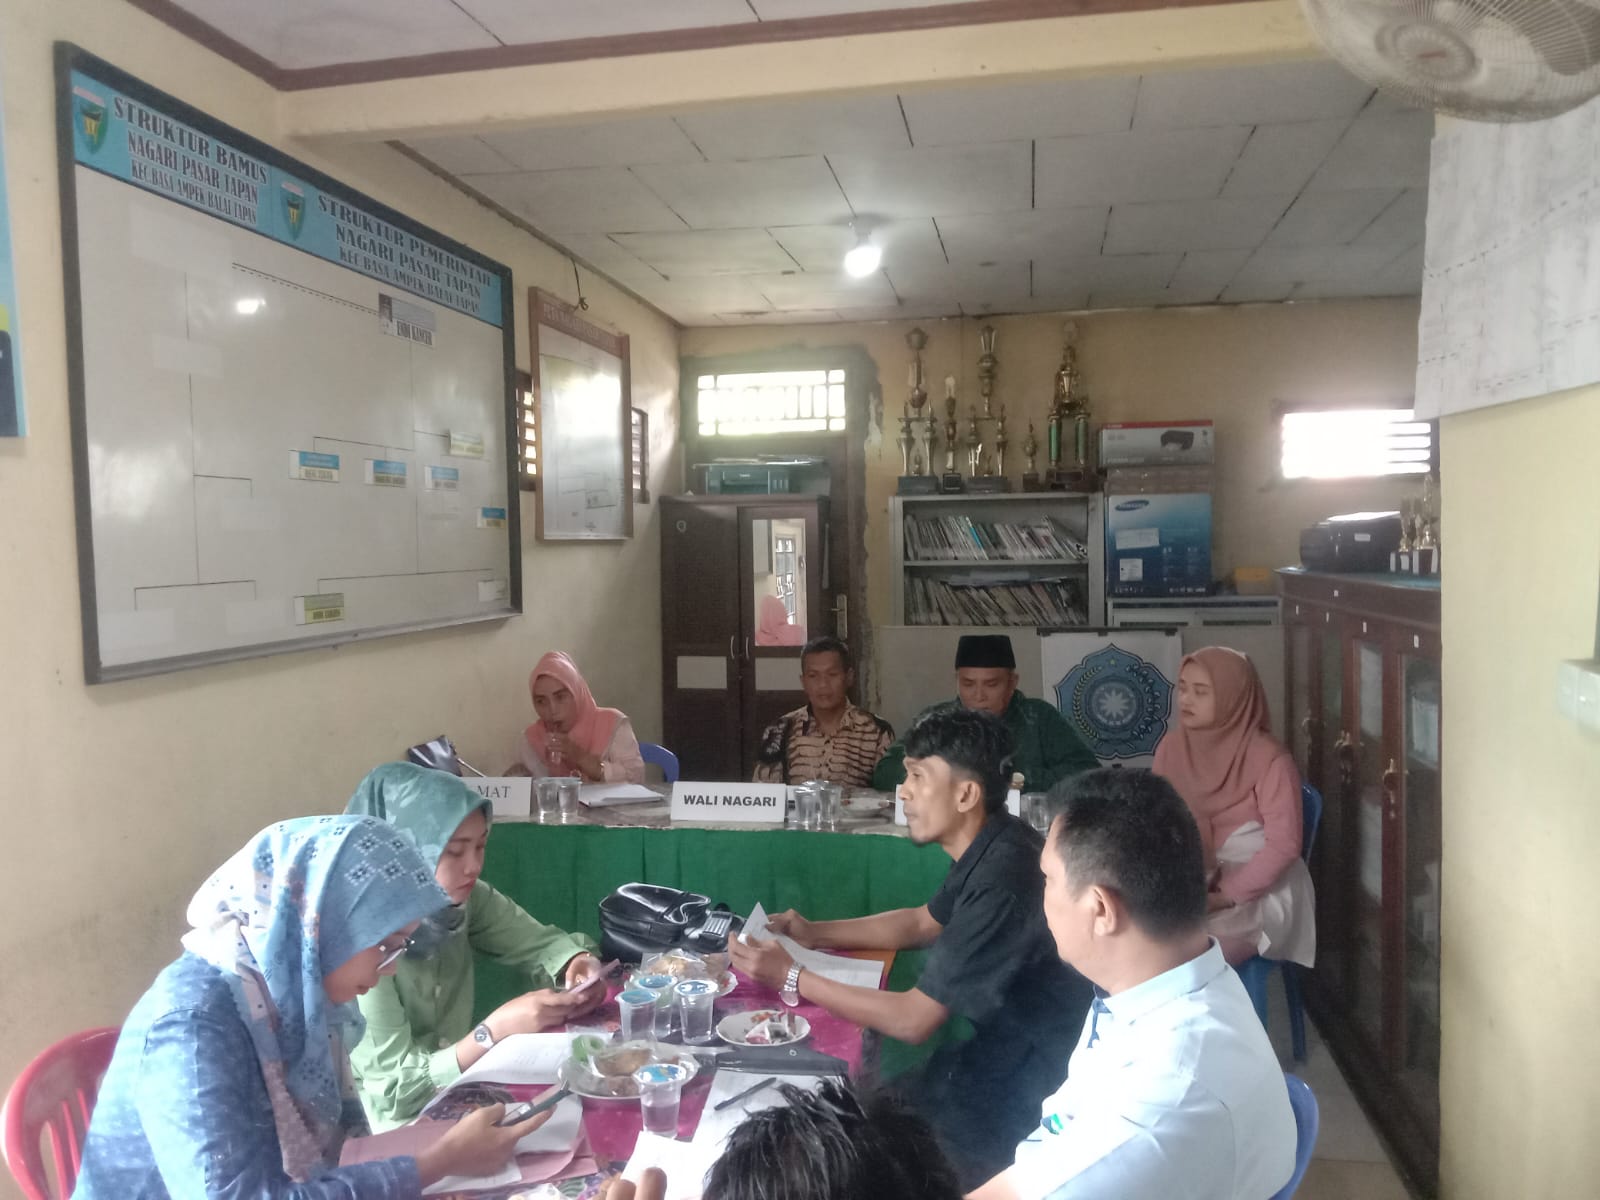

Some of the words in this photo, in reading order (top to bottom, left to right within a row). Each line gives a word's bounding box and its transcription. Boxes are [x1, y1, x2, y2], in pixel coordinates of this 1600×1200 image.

[114, 97, 210, 158] STRUKTUR
[216, 145, 267, 184] BAMUS
[128, 132, 178, 171] NAGARI
[183, 155, 220, 189] PASAR
[225, 175, 258, 205] TAPAN
[318, 195, 404, 247] STRUKTUR
[410, 238, 491, 287] PEMERINTAH
[336, 224, 394, 262] NAGARI
[399, 252, 441, 283] PASAR
[445, 273, 481, 299] TAPAN
[477, 785, 511, 798] MAT
[683, 794, 718, 806] WALI
[722, 796, 776, 807] NAGARI
